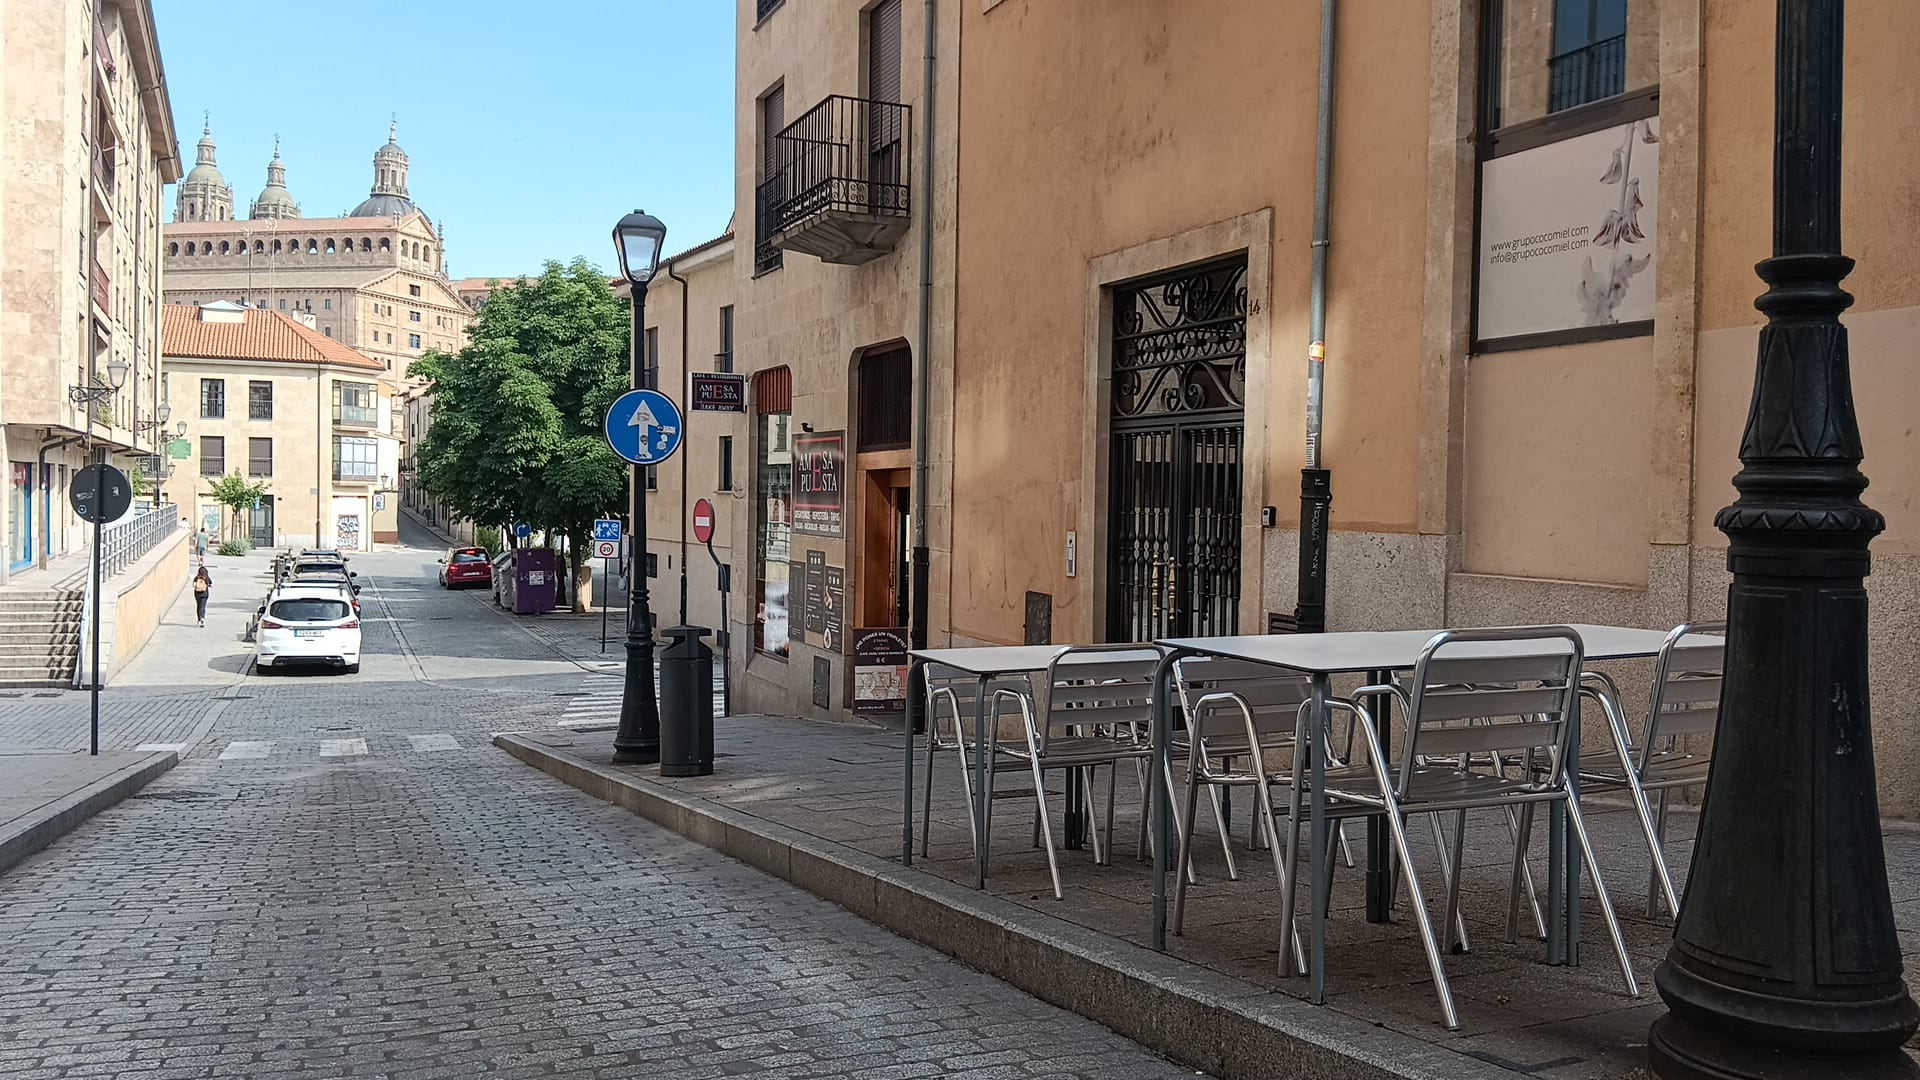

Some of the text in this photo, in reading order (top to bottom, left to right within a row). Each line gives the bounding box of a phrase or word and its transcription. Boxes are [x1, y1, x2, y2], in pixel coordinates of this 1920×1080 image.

[1490, 225, 1589, 252] www.grupococomiel.com
[1490, 239, 1589, 264] info@grupococomiel.com
[1248, 298, 1261, 316] 14
